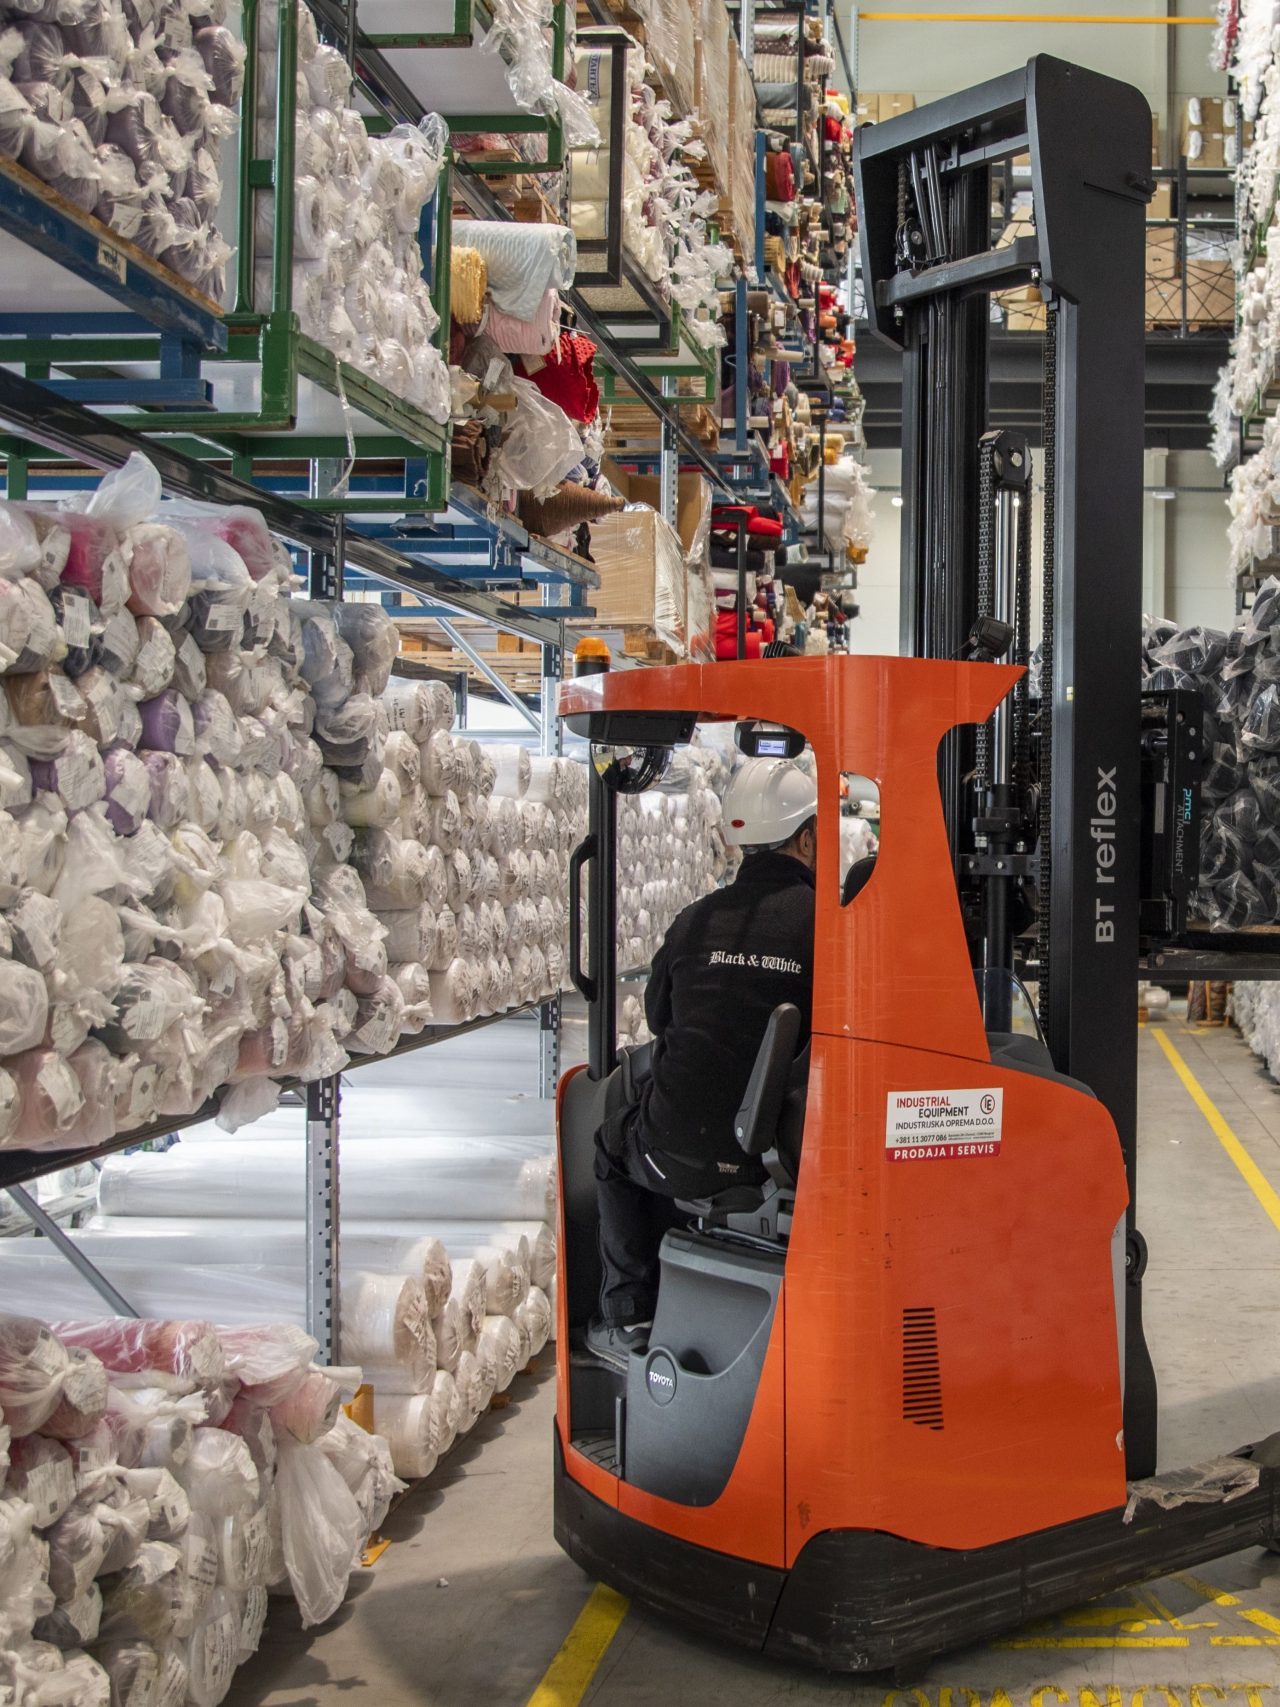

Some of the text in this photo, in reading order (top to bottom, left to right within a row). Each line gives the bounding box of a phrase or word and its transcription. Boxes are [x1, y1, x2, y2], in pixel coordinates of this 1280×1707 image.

[1175, 804, 1185, 873] ATTACHMENT
[1090, 766, 1117, 942] BT reflex
[708, 951, 802, 974] Black & White
[896, 1096, 951, 1109] INDUSTRIAL
[918, 1106, 970, 1119] EQUIPMENT
[895, 1117, 995, 1131] INDUSTRIJSKA OPREMA D.O.O.
[895, 1136, 911, 1144] +381
[920, 1135, 935, 1143] 3077
[894, 1146, 946, 1160] PRODAJA
[957, 1143, 995, 1156] SERVIS
[649, 1371, 674, 1388] TOYOTA
